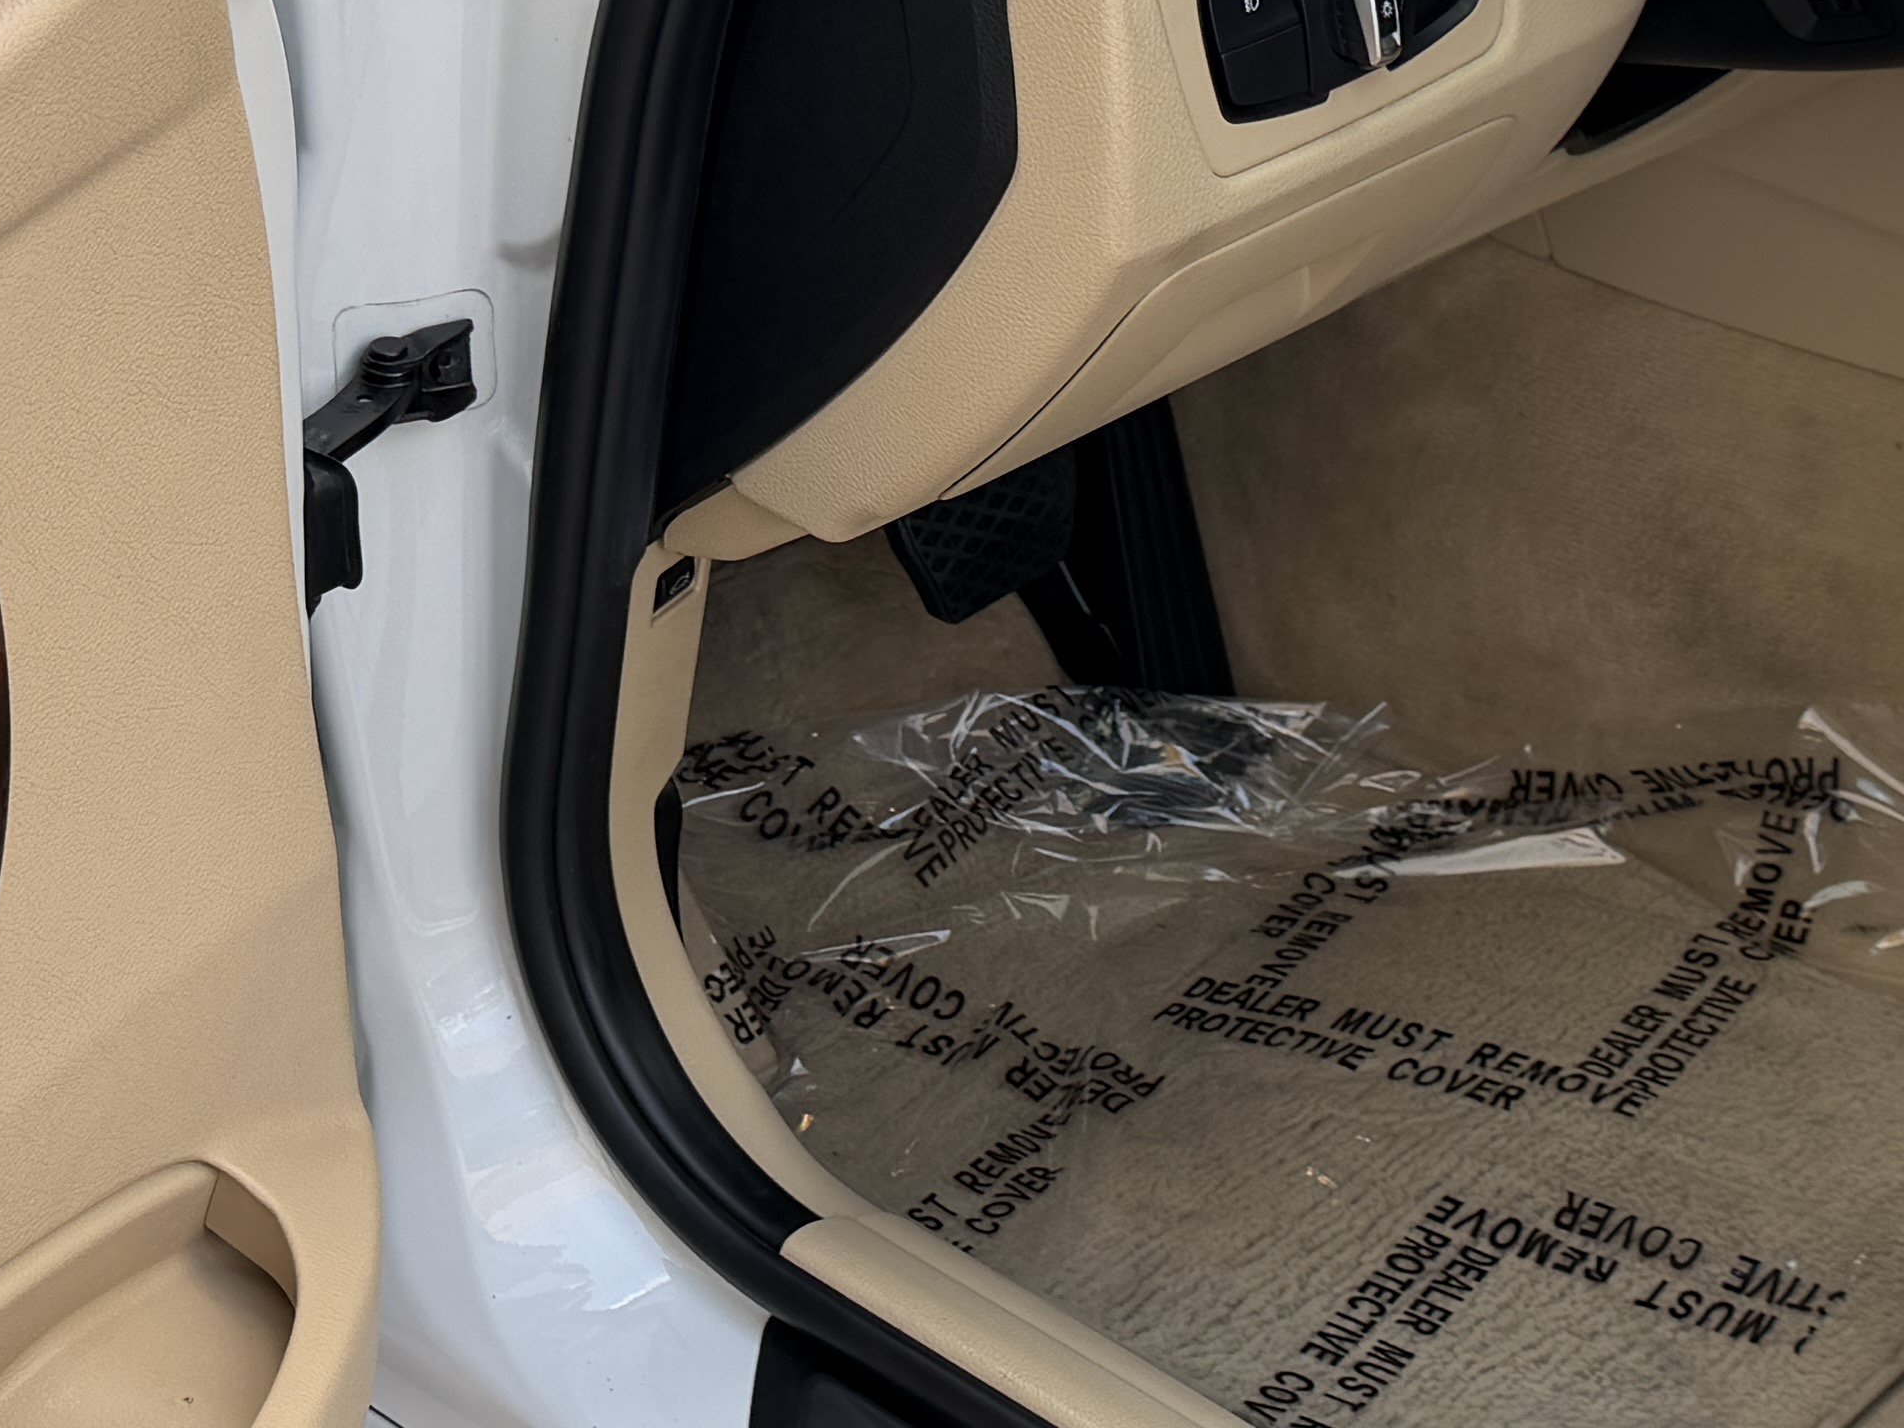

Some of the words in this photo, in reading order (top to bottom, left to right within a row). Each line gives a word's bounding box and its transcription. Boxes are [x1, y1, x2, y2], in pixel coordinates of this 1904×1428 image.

[1576, 1004, 1673, 1079] DEALER
[1652, 933, 1731, 1001] MUST
[1716, 810, 1798, 940] REMOVE
[1153, 1002, 1375, 1072] PROTECTIVE
[1387, 1057, 1526, 1111] COVER
[1183, 976, 1321, 1022] DEALER
[1330, 1007, 1454, 1053] MUST
[1466, 1042, 1644, 1118] REMOVE
[1623, 975, 1758, 1099] PROTECTIVE
[964, 1166, 1064, 1235] COVER
[1425, 1194, 1620, 1284] REMOVE
[1553, 1190, 1704, 1271] COVER
[1299, 1224, 1453, 1367] PROTECTIVE
[1396, 1244, 1500, 1336] DEALER
[1634, 1278, 1778, 1345] MUST
[1322, 1339, 1417, 1412] MUST
